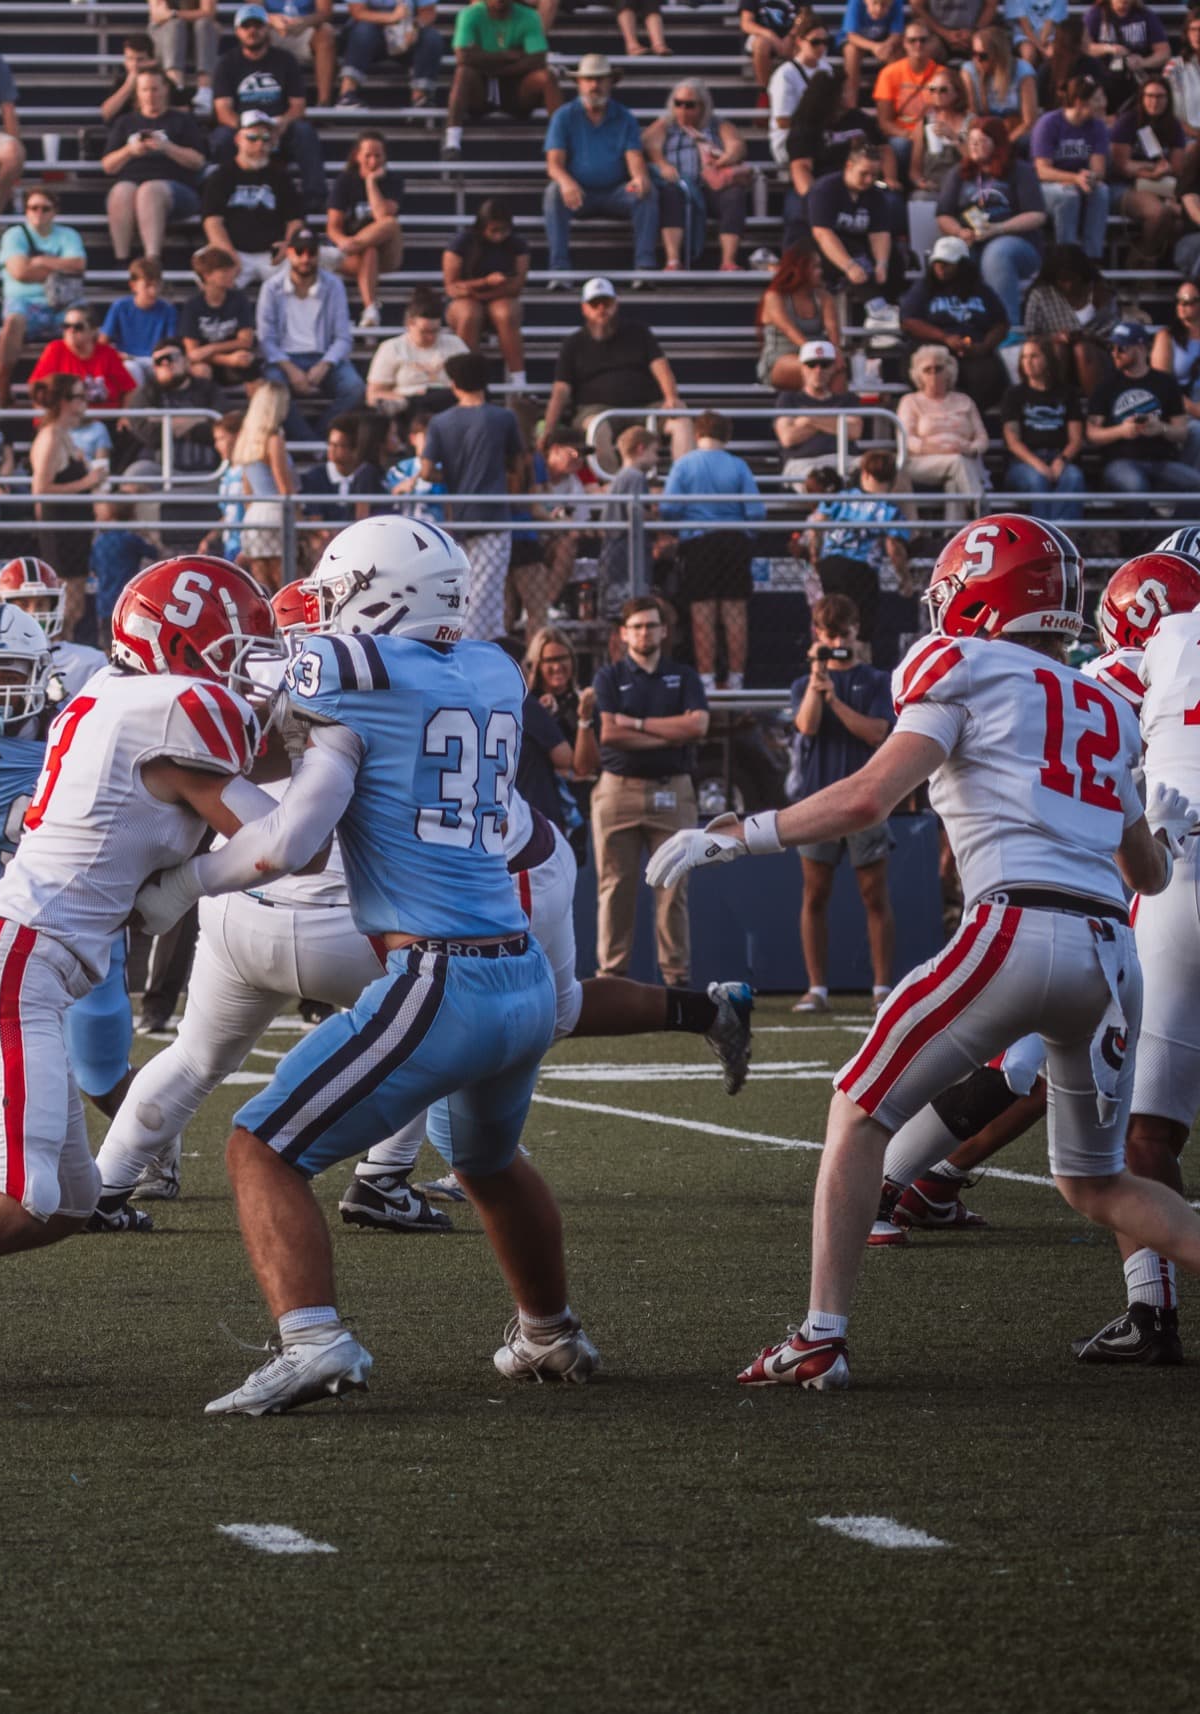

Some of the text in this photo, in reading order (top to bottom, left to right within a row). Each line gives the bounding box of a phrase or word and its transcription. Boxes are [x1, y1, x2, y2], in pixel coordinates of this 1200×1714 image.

[964, 524, 1000, 578] S
[1042, 540, 1055, 553] 12
[162, 570, 213, 629] S
[447, 594, 460, 609] 33
[1126, 578, 1169, 630] S
[1032, 667, 1125, 814] 12
[413, 706, 519, 855] 33
